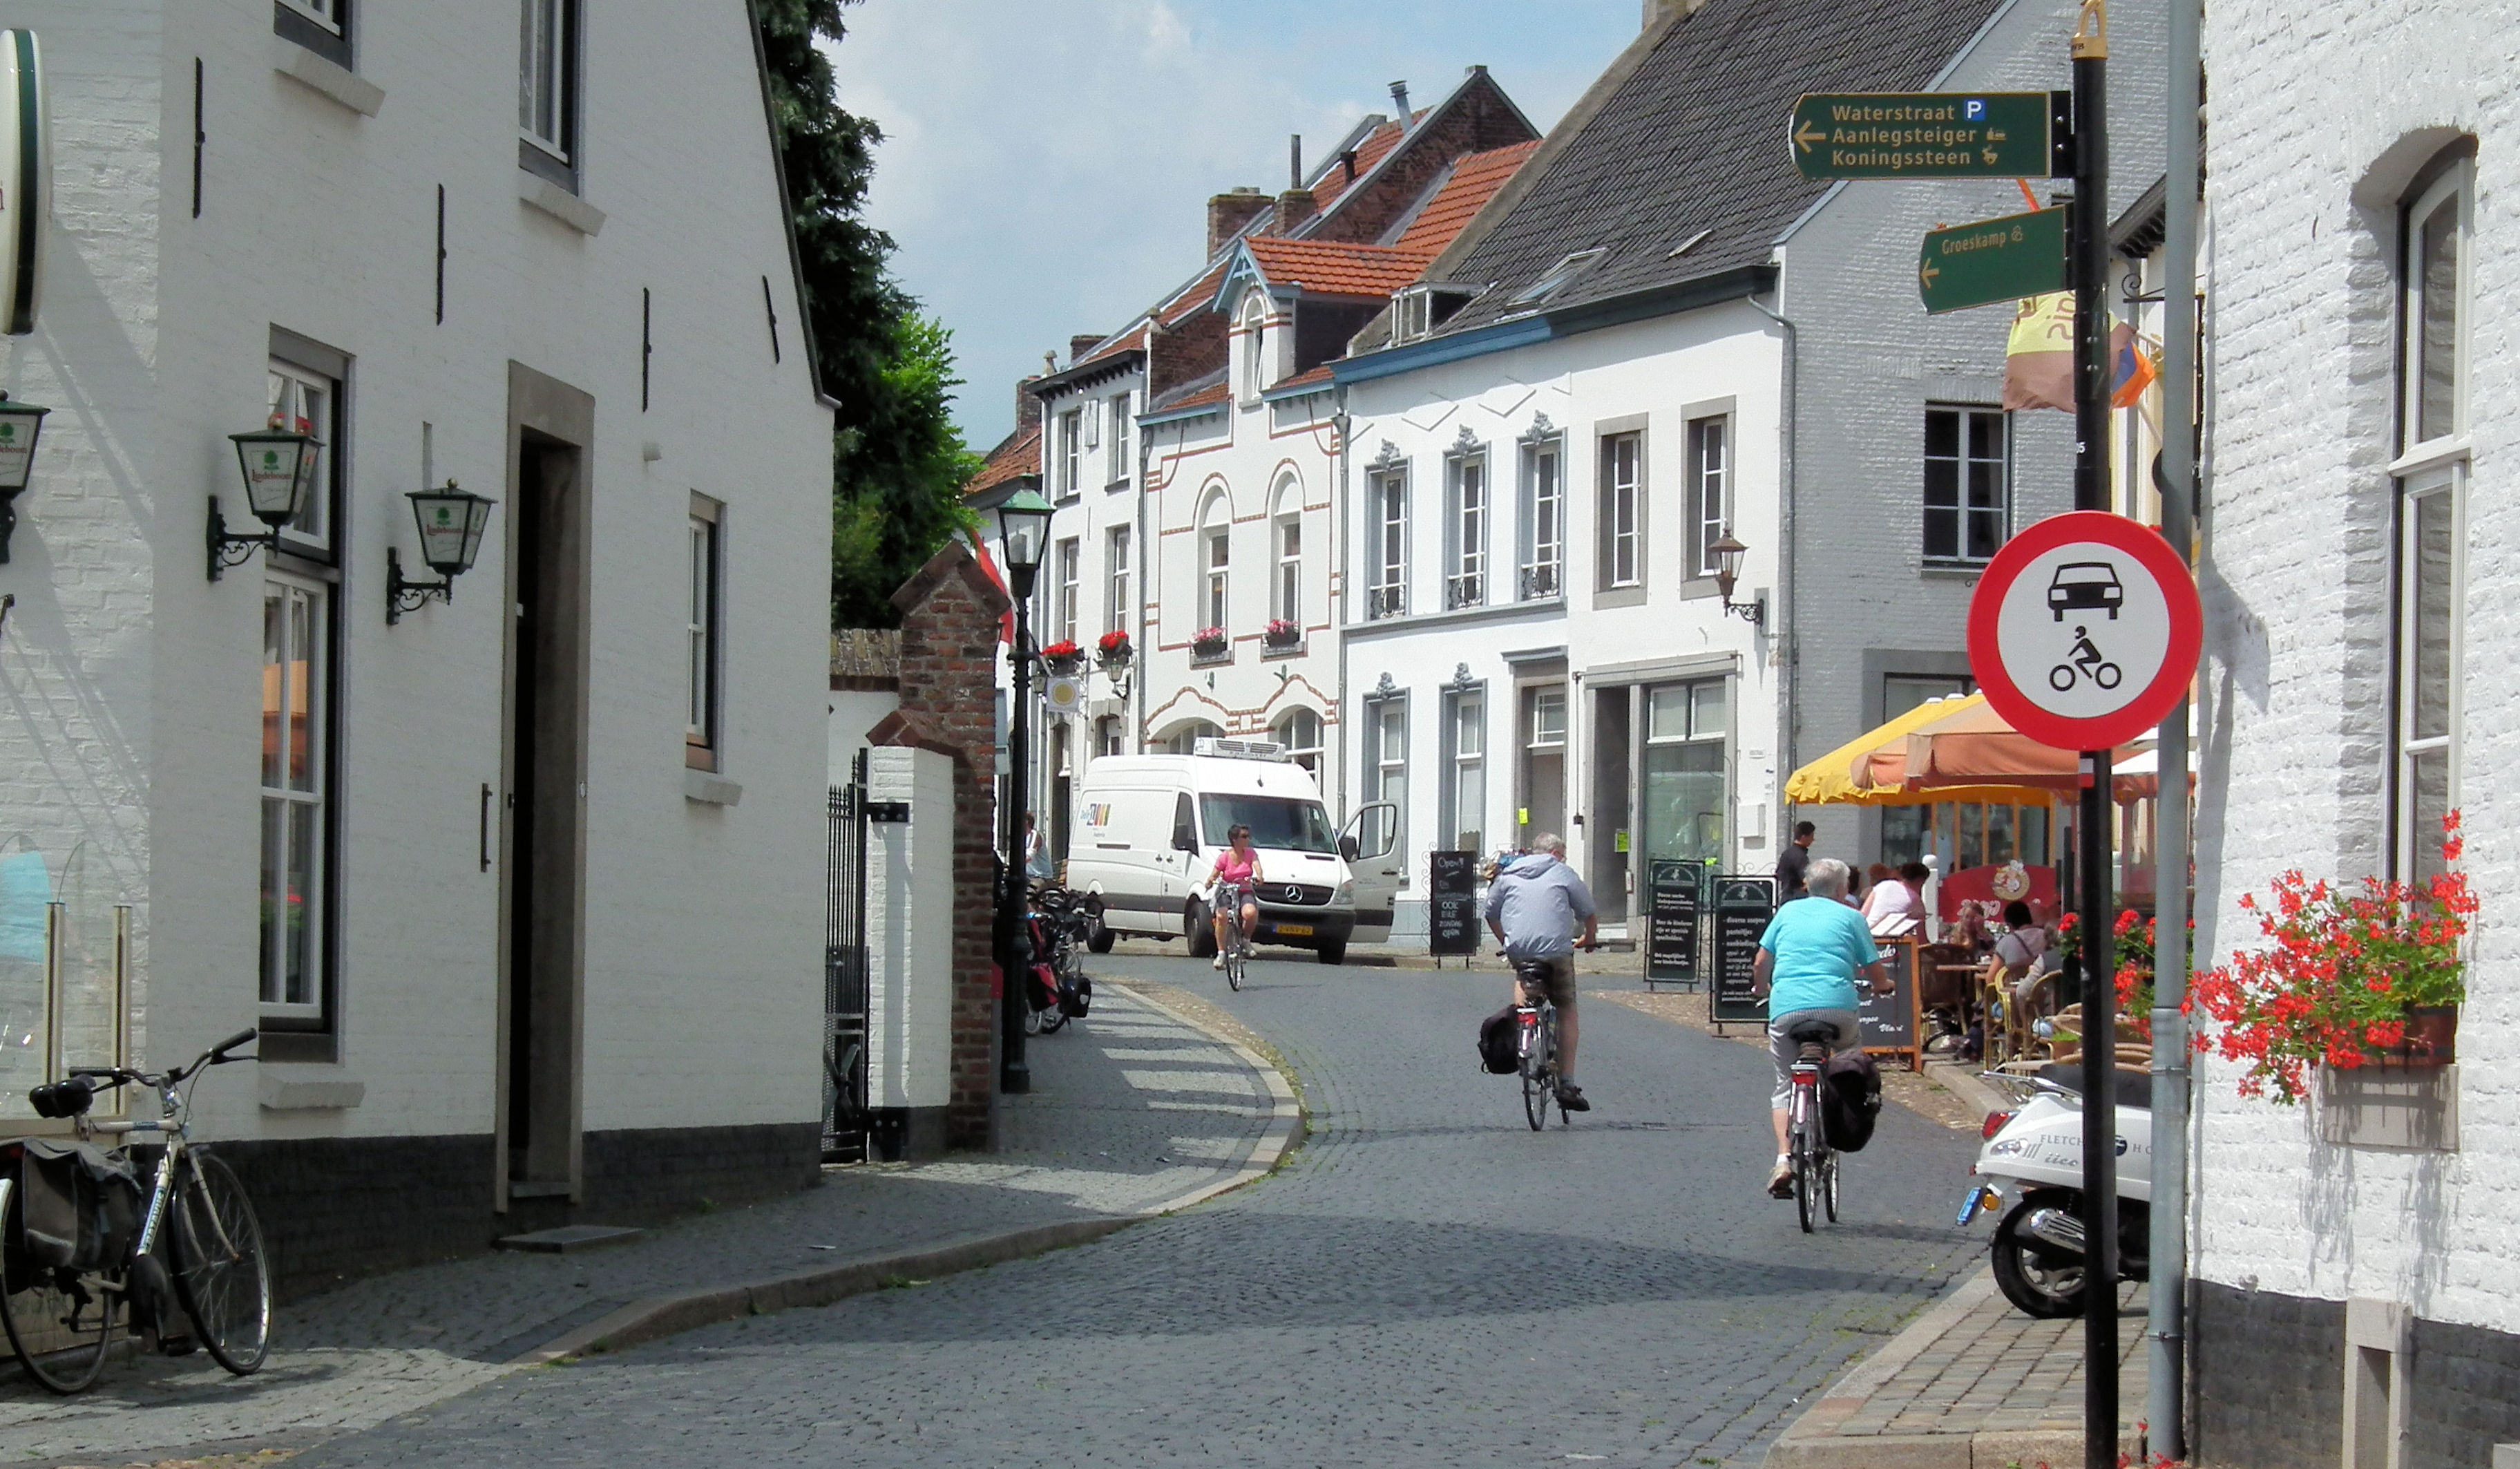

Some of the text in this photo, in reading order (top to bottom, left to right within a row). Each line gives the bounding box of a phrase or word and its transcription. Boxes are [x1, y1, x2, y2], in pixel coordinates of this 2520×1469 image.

[1832, 100, 1982, 122] Waterstraat P
[1832, 126, 1977, 147] Aanlegsteiger
[1833, 149, 1970, 169] Koningssteen
[1942, 231, 2006, 255] Groeskamp
[2040, 1134, 2084, 1146] FLETCH
